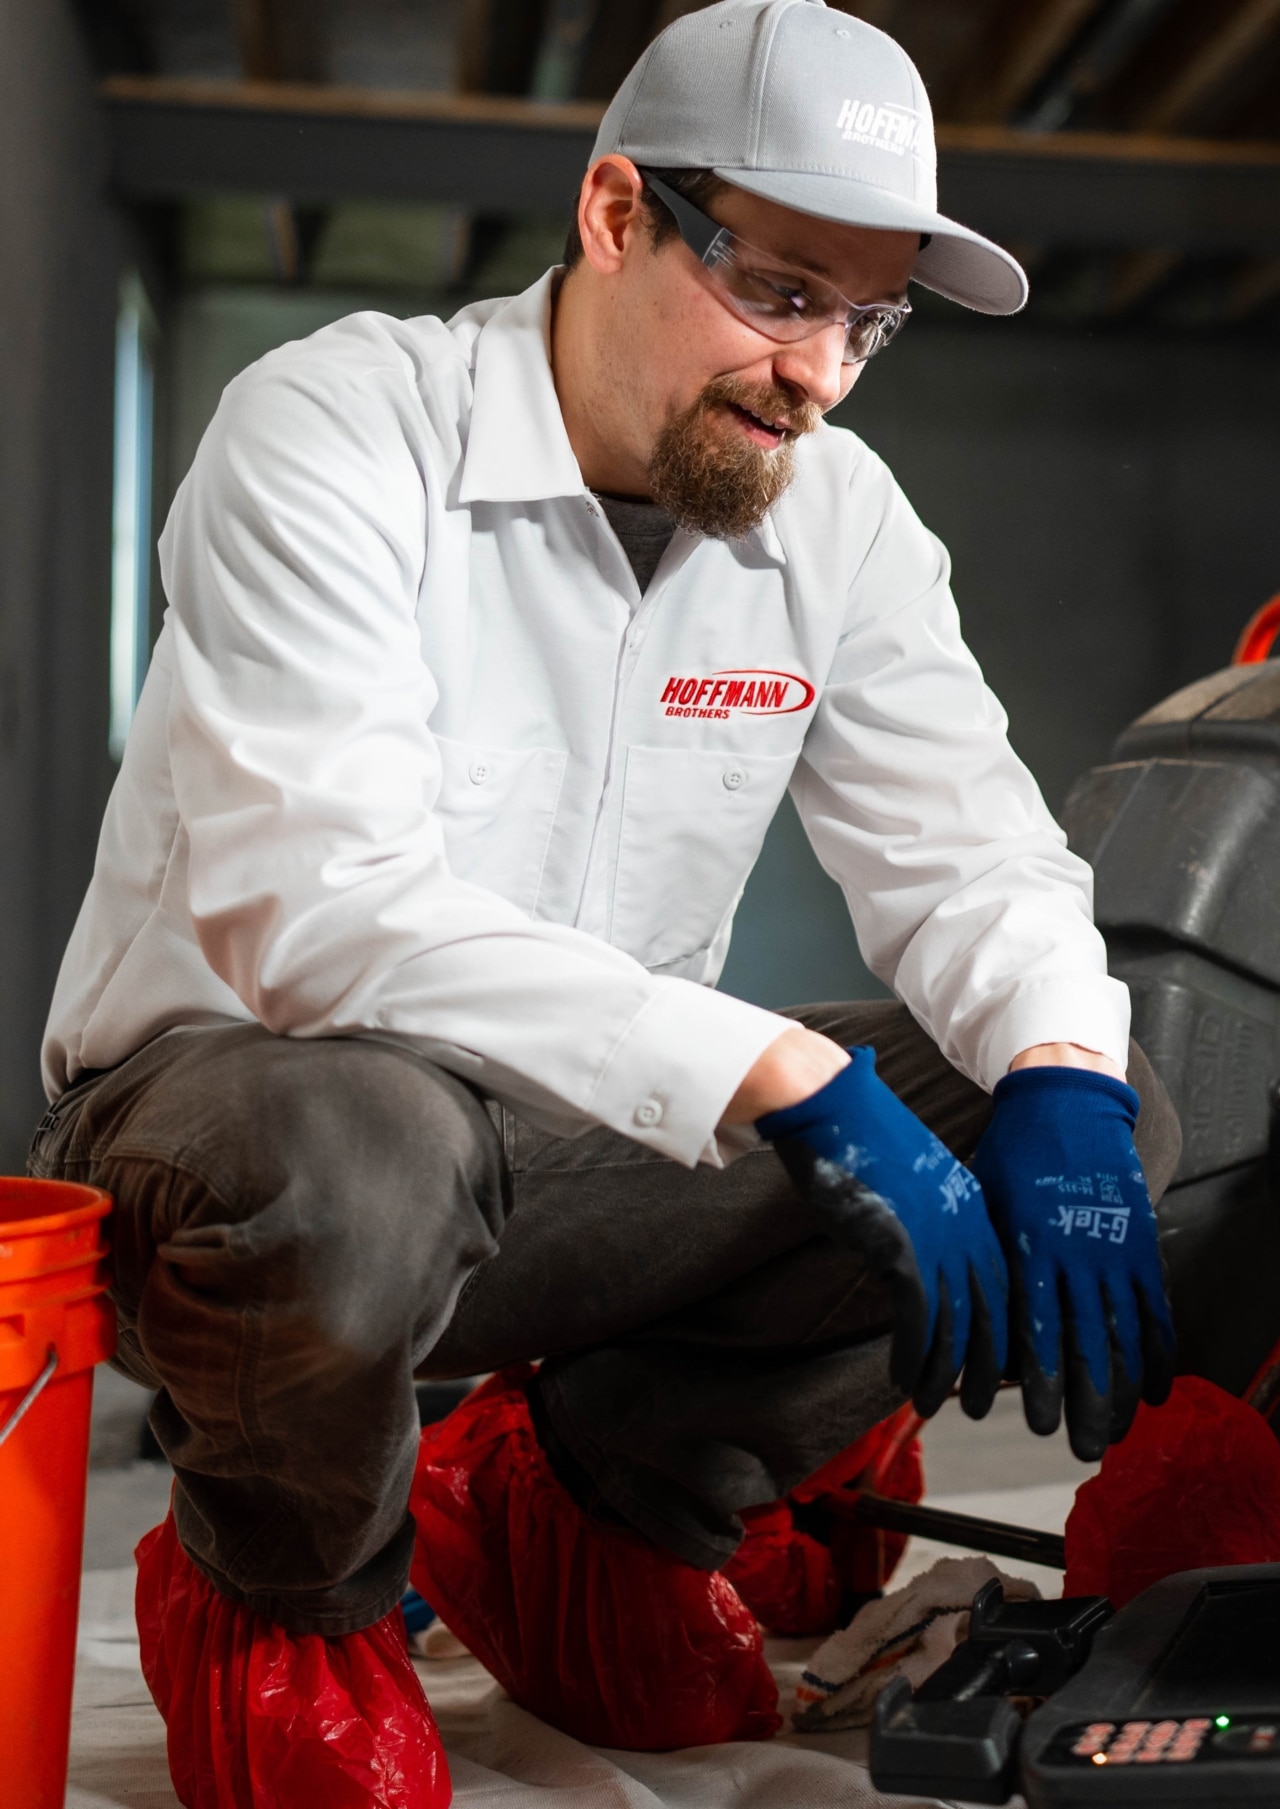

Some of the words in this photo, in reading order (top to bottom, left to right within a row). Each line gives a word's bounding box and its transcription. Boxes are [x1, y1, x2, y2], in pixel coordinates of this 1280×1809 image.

[836, 99, 925, 154] HOFFMA
[842, 130, 905, 157] BROTHERS
[660, 677, 789, 708] HOFFMANN
[665, 706, 730, 719] BROTHERS
[1057, 1205, 1129, 1244] G-Tek
